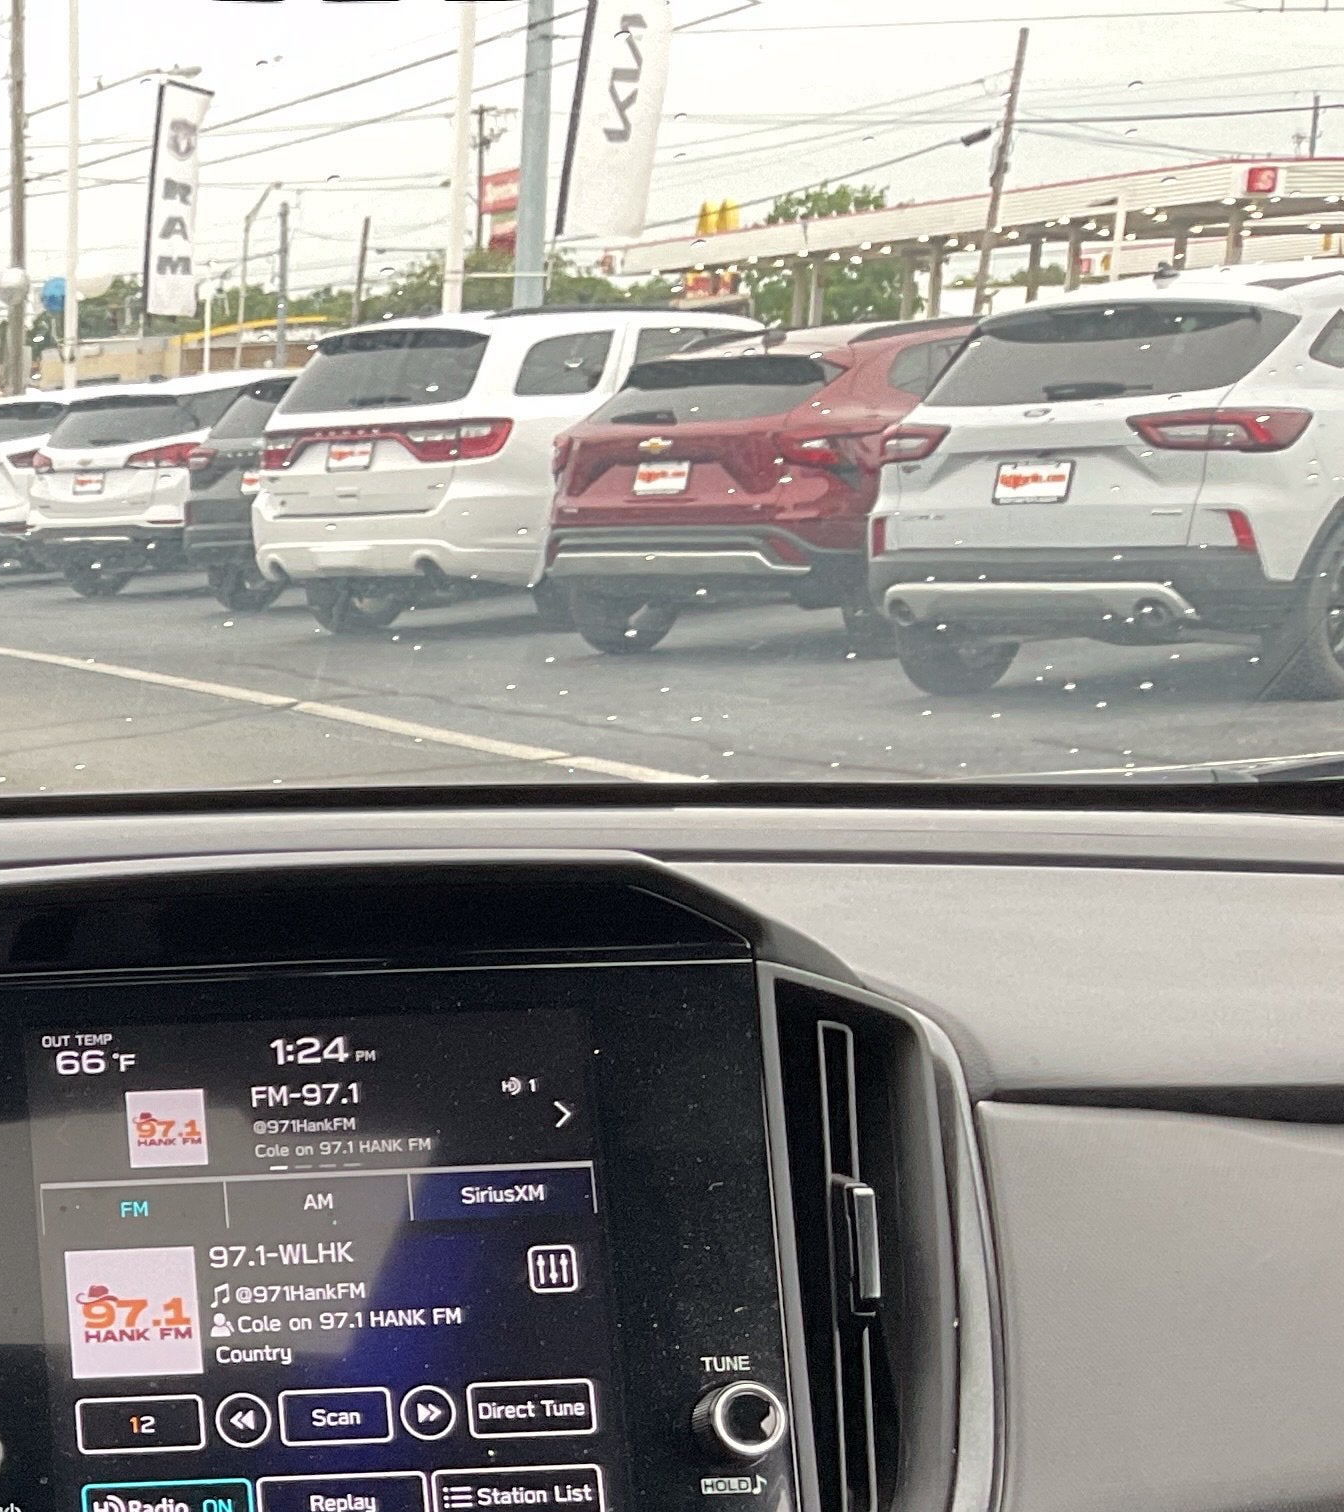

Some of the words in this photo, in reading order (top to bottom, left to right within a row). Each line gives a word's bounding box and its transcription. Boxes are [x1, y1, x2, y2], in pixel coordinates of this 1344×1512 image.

[155, 176, 193, 277] RAM
[41, 1034, 72, 1049] OUT
[74, 1033, 113, 1048] TEMP
[269, 1037, 349, 1066] 1:24
[355, 1048, 376, 1062] PM
[55, 1051, 106, 1075] 66
[250, 1083, 360, 1109] FM-97.1
[528, 1079, 537, 1093] 1
[134, 1119, 202, 1140] 97.1
[252, 1116, 356, 1135] @971HankFM
[137, 1136, 177, 1147] HANK
[181, 1135, 203, 1146] FM
[254, 1142, 289, 1159] Cole
[295, 1144, 314, 1157] on
[320, 1141, 355, 1156] 97.1
[359, 1139, 402, 1154] HANK
[408, 1137, 432, 1153] FM
[303, 1193, 334, 1210] AM
[460, 1184, 545, 1205] SiriusXM
[119, 1200, 149, 1218] FM
[209, 1242, 354, 1269] 97.1-WLHK
[235, 1282, 366, 1305] @971HankFM
[80, 1297, 192, 1329] 97.1
[237, 1314, 282, 1333] Cole
[288, 1316, 313, 1332] on
[319, 1311, 364, 1330] 97.1
[370, 1309, 427, 1328] HANK
[433, 1307, 463, 1326] FM
[84, 1328, 151, 1344] HANK
[159, 1325, 194, 1341] FM
[215, 1344, 293, 1366] Country
[700, 1355, 751, 1372] TUNE
[311, 1407, 361, 1428] Scan
[477, 1400, 536, 1420] Direct
[541, 1398, 586, 1418] Tune
[128, 1415, 156, 1434] 12
[476, 1484, 546, 1506] Station
[554, 1483, 593, 1504] List
